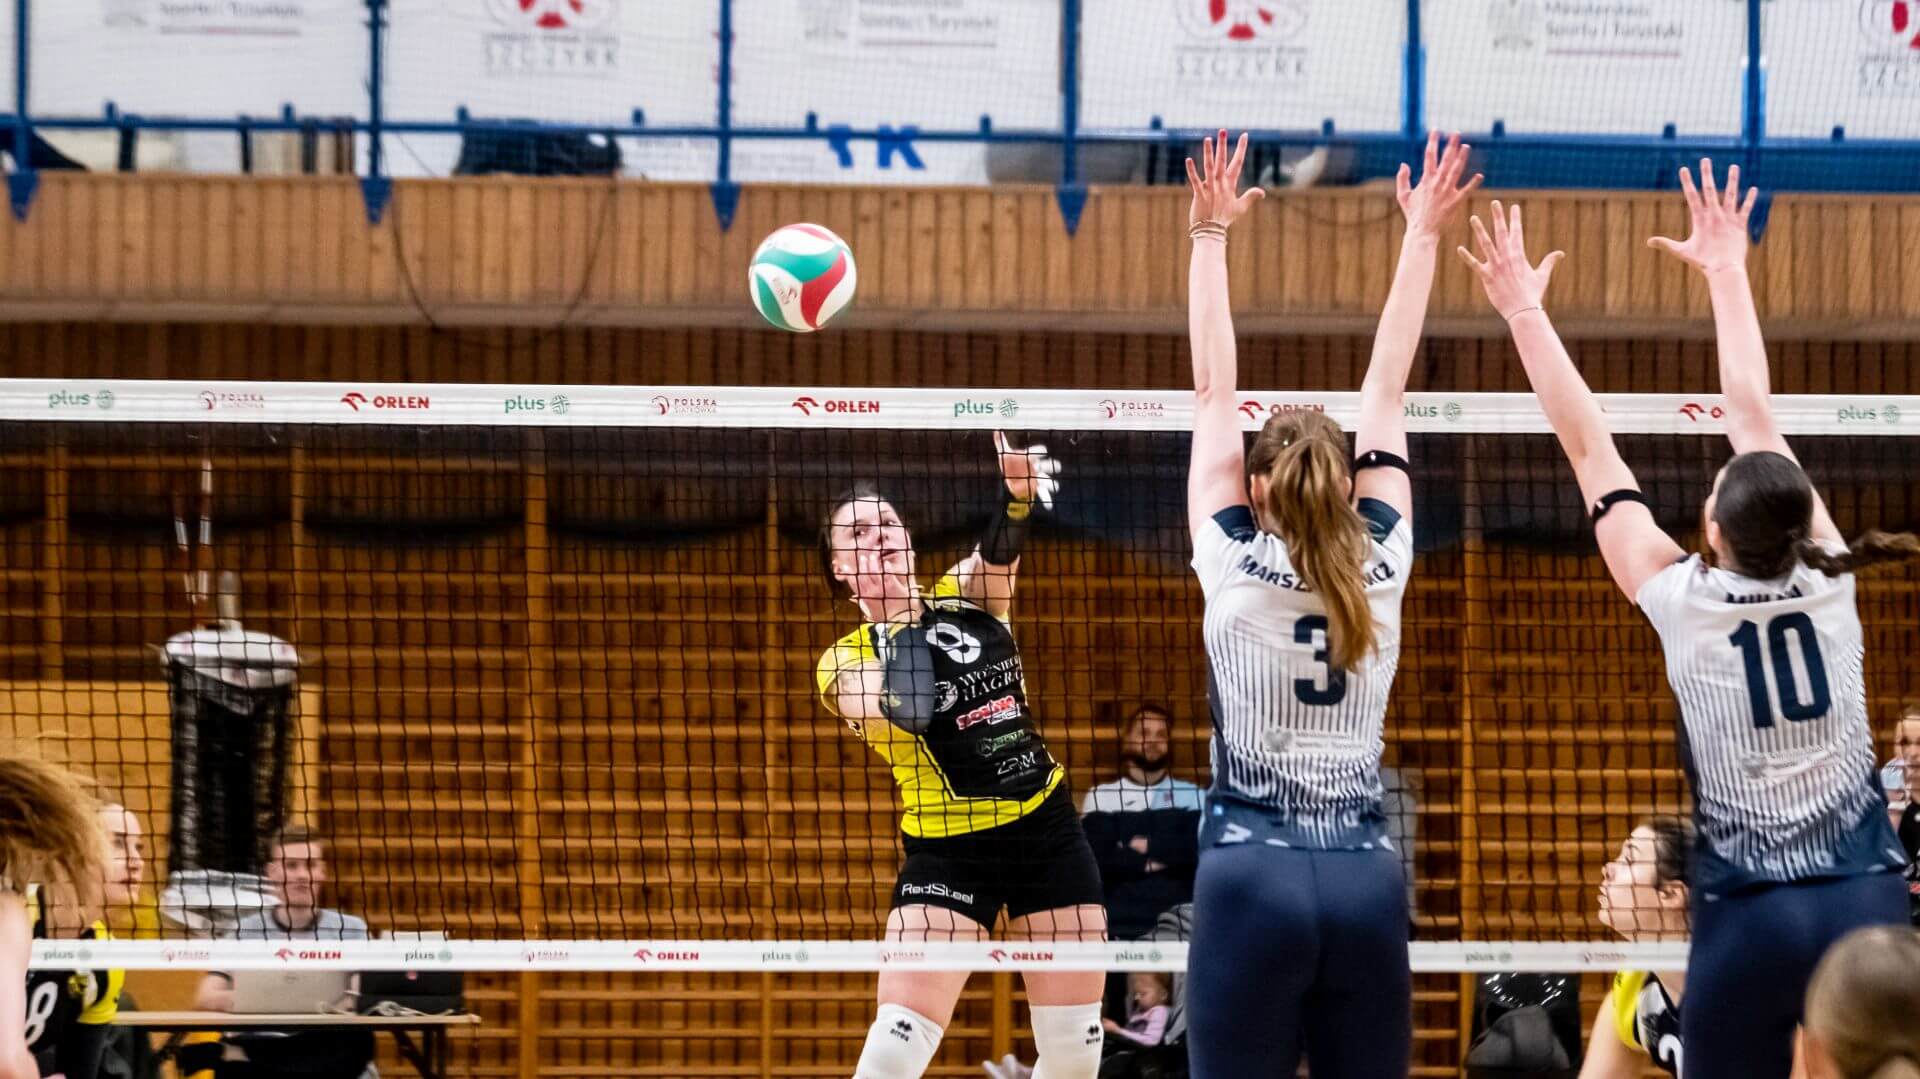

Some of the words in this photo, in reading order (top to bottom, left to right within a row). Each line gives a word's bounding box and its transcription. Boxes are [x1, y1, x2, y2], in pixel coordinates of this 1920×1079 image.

[48, 389, 91, 409] plus
[373, 395, 430, 409] ORLEN
[504, 395, 545, 413] plus
[824, 400, 880, 413] ORLEN
[954, 399, 994, 418] plus
[1837, 405, 1876, 423] plus
[1294, 614, 1346, 706] 3
[1728, 611, 1832, 728] 10
[901, 882, 974, 905] RedSteel
[299, 951, 341, 960] ORLEN
[405, 950, 435, 962] plus
[657, 952, 699, 961] ORLEN
[762, 951, 792, 963] plus
[1012, 952, 1053, 961] ORLEN
[1116, 951, 1144, 963] plus
